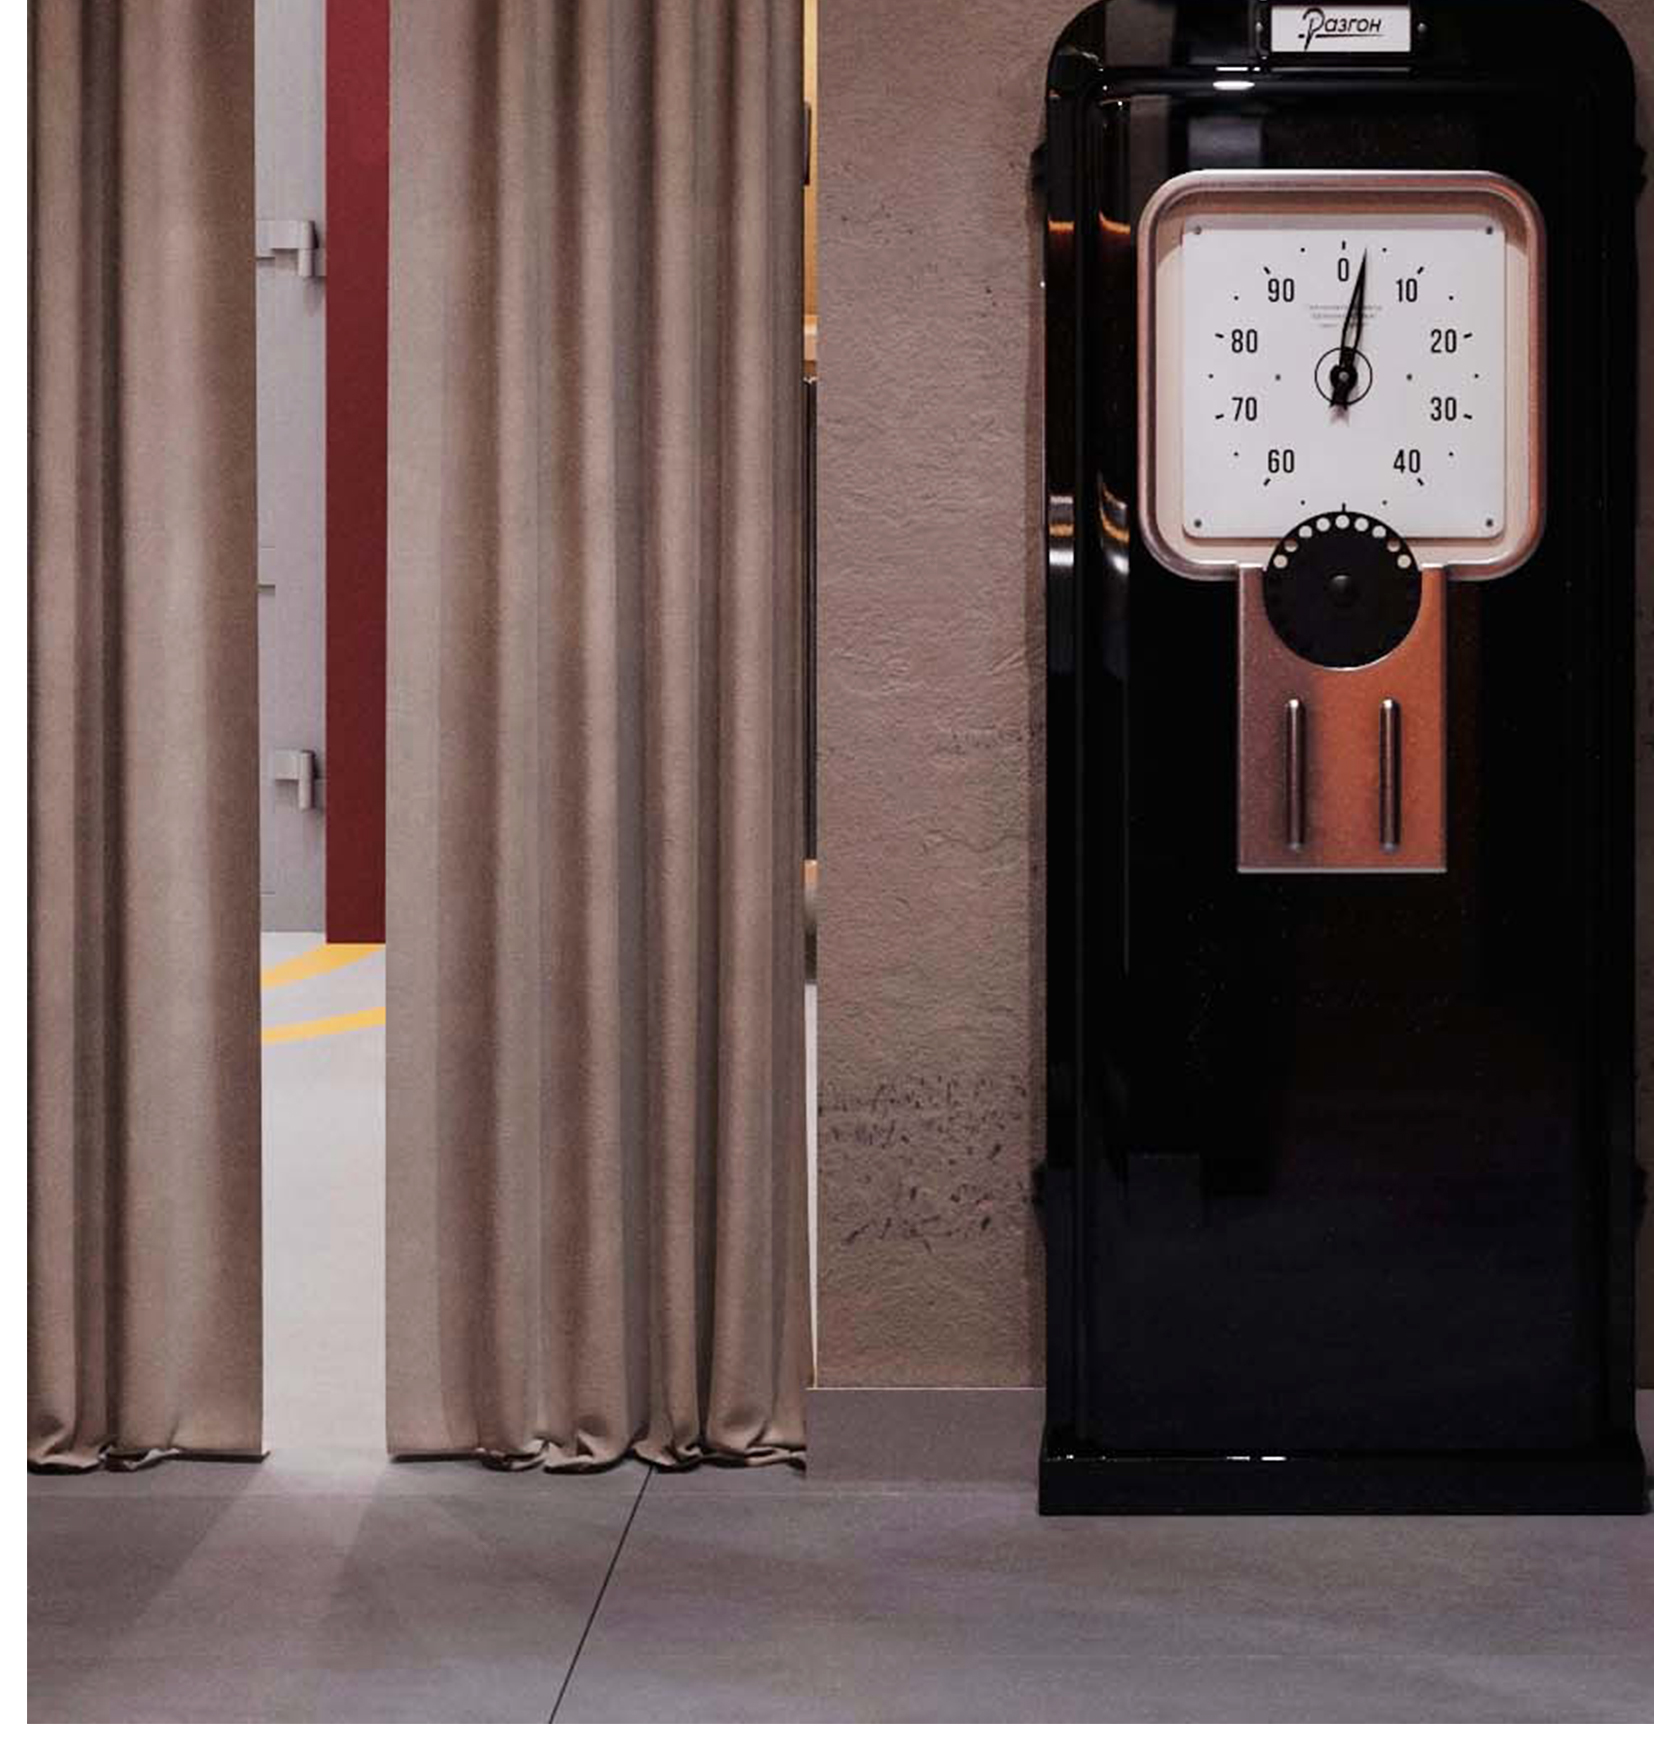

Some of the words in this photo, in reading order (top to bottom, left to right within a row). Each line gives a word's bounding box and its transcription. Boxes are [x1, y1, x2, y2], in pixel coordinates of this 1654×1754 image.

[1302, 7, 1382, 51] Разгон
[1337, 257, 1350, 282] 0
[1267, 278, 1295, 303] 90
[1396, 278, 1418, 303] 10
[1231, 328, 1258, 354] 80
[1430, 328, 1457, 354] 20
[1231, 396, 1258, 422] 70
[1430, 396, 1457, 422] 30
[1267, 449, 1295, 474] 60
[1393, 449, 1421, 474] 40
